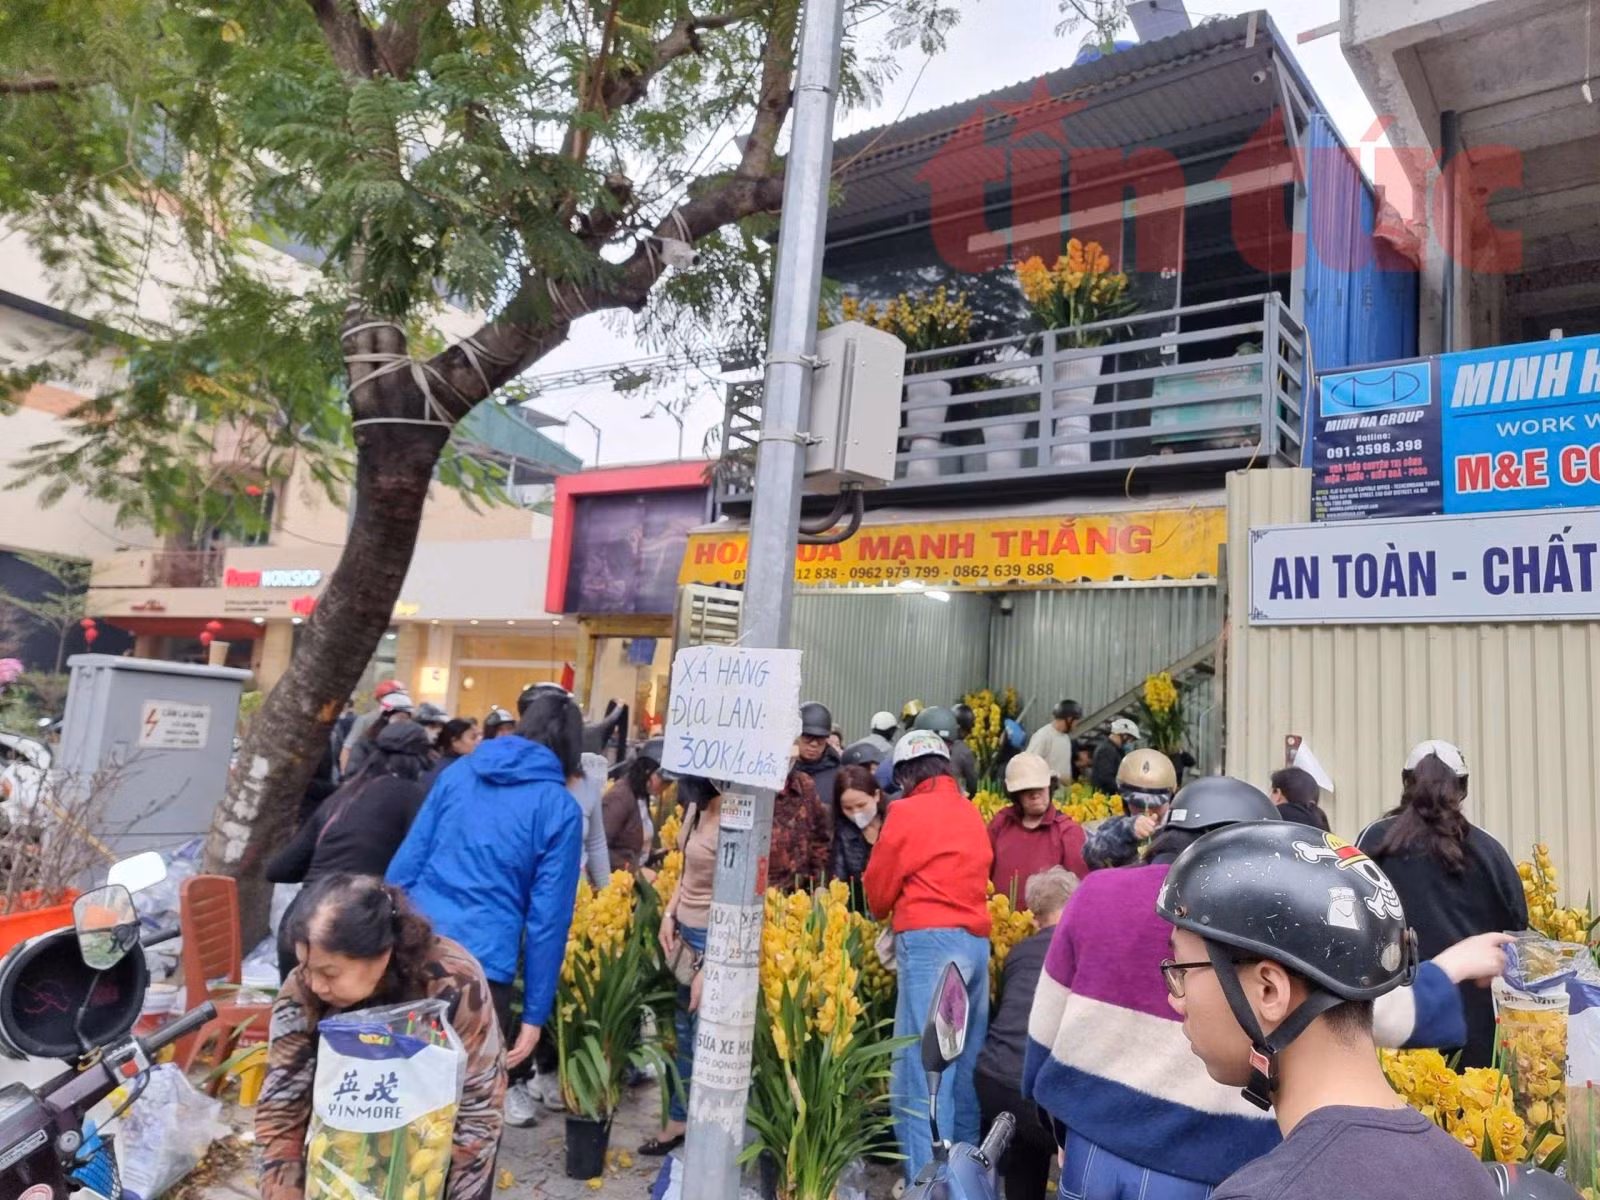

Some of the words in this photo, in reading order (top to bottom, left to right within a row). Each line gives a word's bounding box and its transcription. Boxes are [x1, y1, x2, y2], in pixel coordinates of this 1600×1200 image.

[1451, 352, 1573, 408] MINH
[1325, 418, 1358, 432] MINH
[1379, 410, 1424, 426] GROUP
[1496, 415, 1576, 437] WORK
[1356, 433, 1391, 442] Hotline:
[1327, 439, 1422, 459] 091.3598.398
[1455, 448, 1549, 494] M&E
[858, 531, 975, 565] MẠNH
[992, 516, 1152, 557] THẮNG
[797, 567, 811, 580] 12
[814, 567, 837, 579] 838
[850, 566, 881, 579] 0962
[885, 566, 910, 578] 979
[914, 566, 940, 578] 799
[953, 565, 989, 578] 0862
[994, 564, 1021, 577] 639
[1026, 563, 1054, 576] 888
[1268, 555, 1320, 600] AN
[1332, 542, 1436, 599] TOÀN
[1452, 570, 1467, 581] -
[1483, 526, 1597, 595] CHẤT
[328, 1104, 404, 1119] YINMORE
